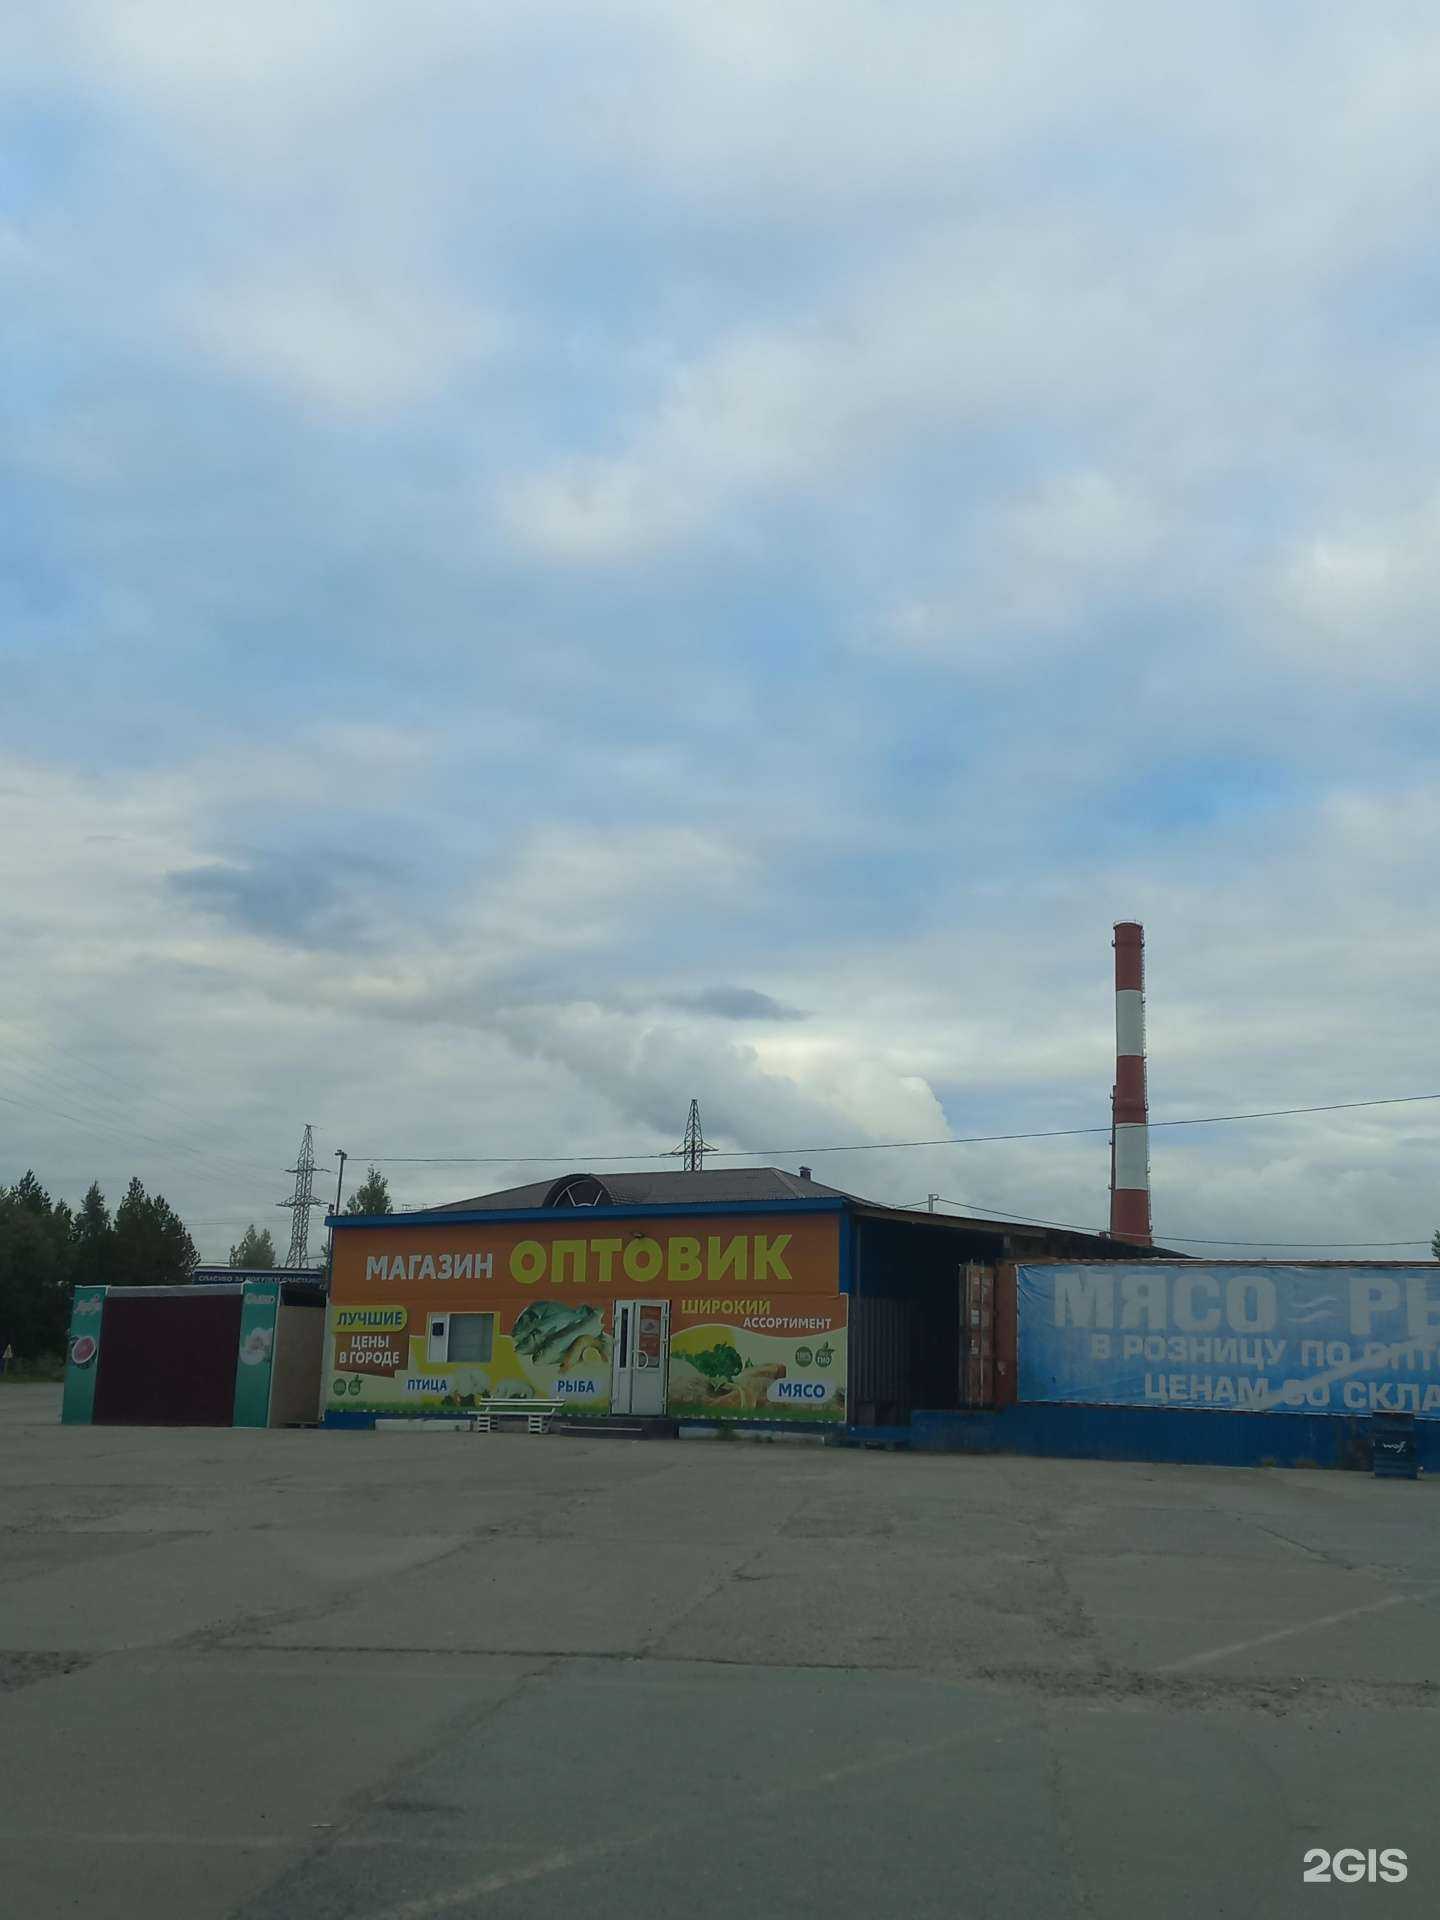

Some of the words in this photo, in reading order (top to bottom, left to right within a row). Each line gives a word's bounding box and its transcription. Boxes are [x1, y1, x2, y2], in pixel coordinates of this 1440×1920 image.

[365, 1253, 493, 1281] МАГАЗИН
[509, 1234, 793, 1285] ОПТОВИК
[1053, 1273, 1277, 1332] МЯСО
[336, 1311, 403, 1327] ЛУЧШИЕ
[743, 1316, 832, 1330] АССОРТИМЕНТ
[351, 1335, 389, 1350] ЦЕНЫ
[339, 1351, 347, 1363] В
[350, 1350, 400, 1366] ГОРОДЕ
[1091, 1333, 1109, 1360] В
[1123, 1334, 1288, 1372] РОЗНИЦУ
[1301, 1339, 1351, 1368] ПО
[407, 1379, 448, 1393] ПТИЦА
[557, 1380, 594, 1393] РЫБА
[778, 1382, 826, 1399] МЯСО
[1144, 1374, 1269, 1407] ЦЕНАМ
[1282, 1379, 1330, 1407] СО
[1344, 1380, 1440, 1412] СКЛА
